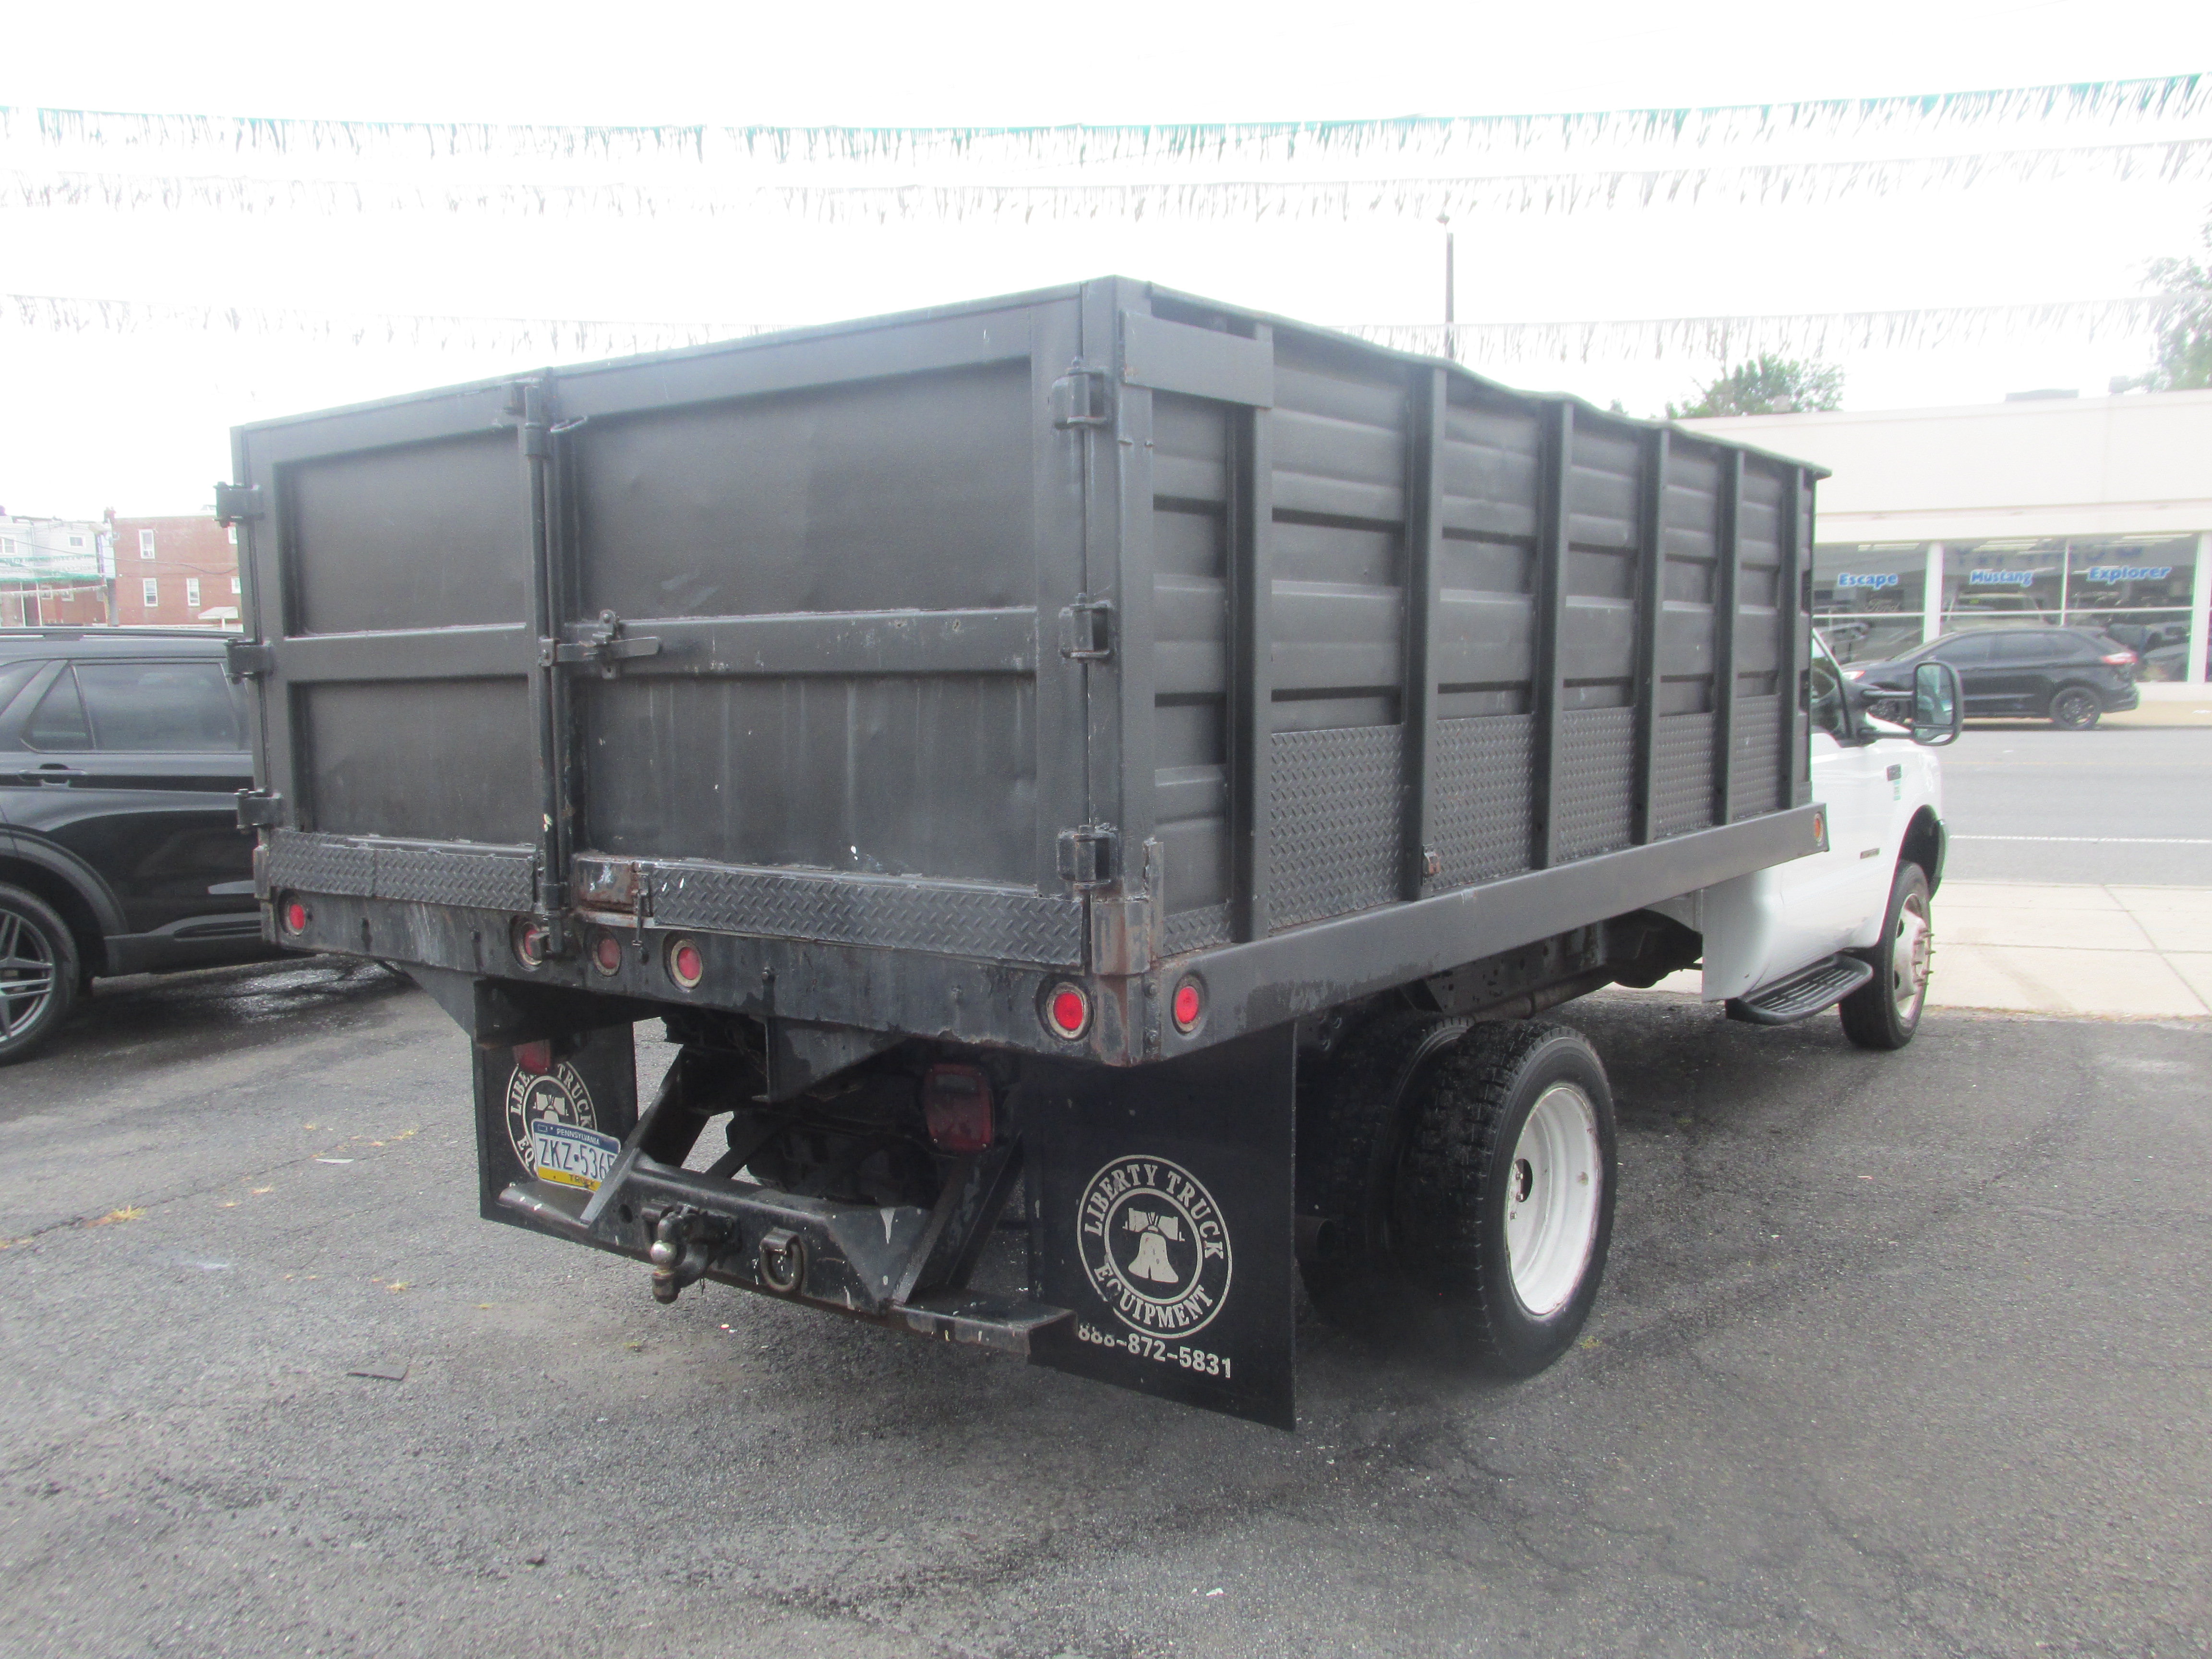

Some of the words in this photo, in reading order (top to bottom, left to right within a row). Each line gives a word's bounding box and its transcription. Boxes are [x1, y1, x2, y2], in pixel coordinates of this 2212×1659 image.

[1838, 573, 1898, 590] Escape
[1970, 570, 2033, 587] Mustang
[2088, 565, 2172, 585] Explorer
[557, 1063, 592, 1128] TRUCK
[556, 1128, 600, 1145] PENNSYLVANIA
[1084, 1164, 1158, 1237] LIBERTY
[1166, 1171, 1224, 1259] TRUCK
